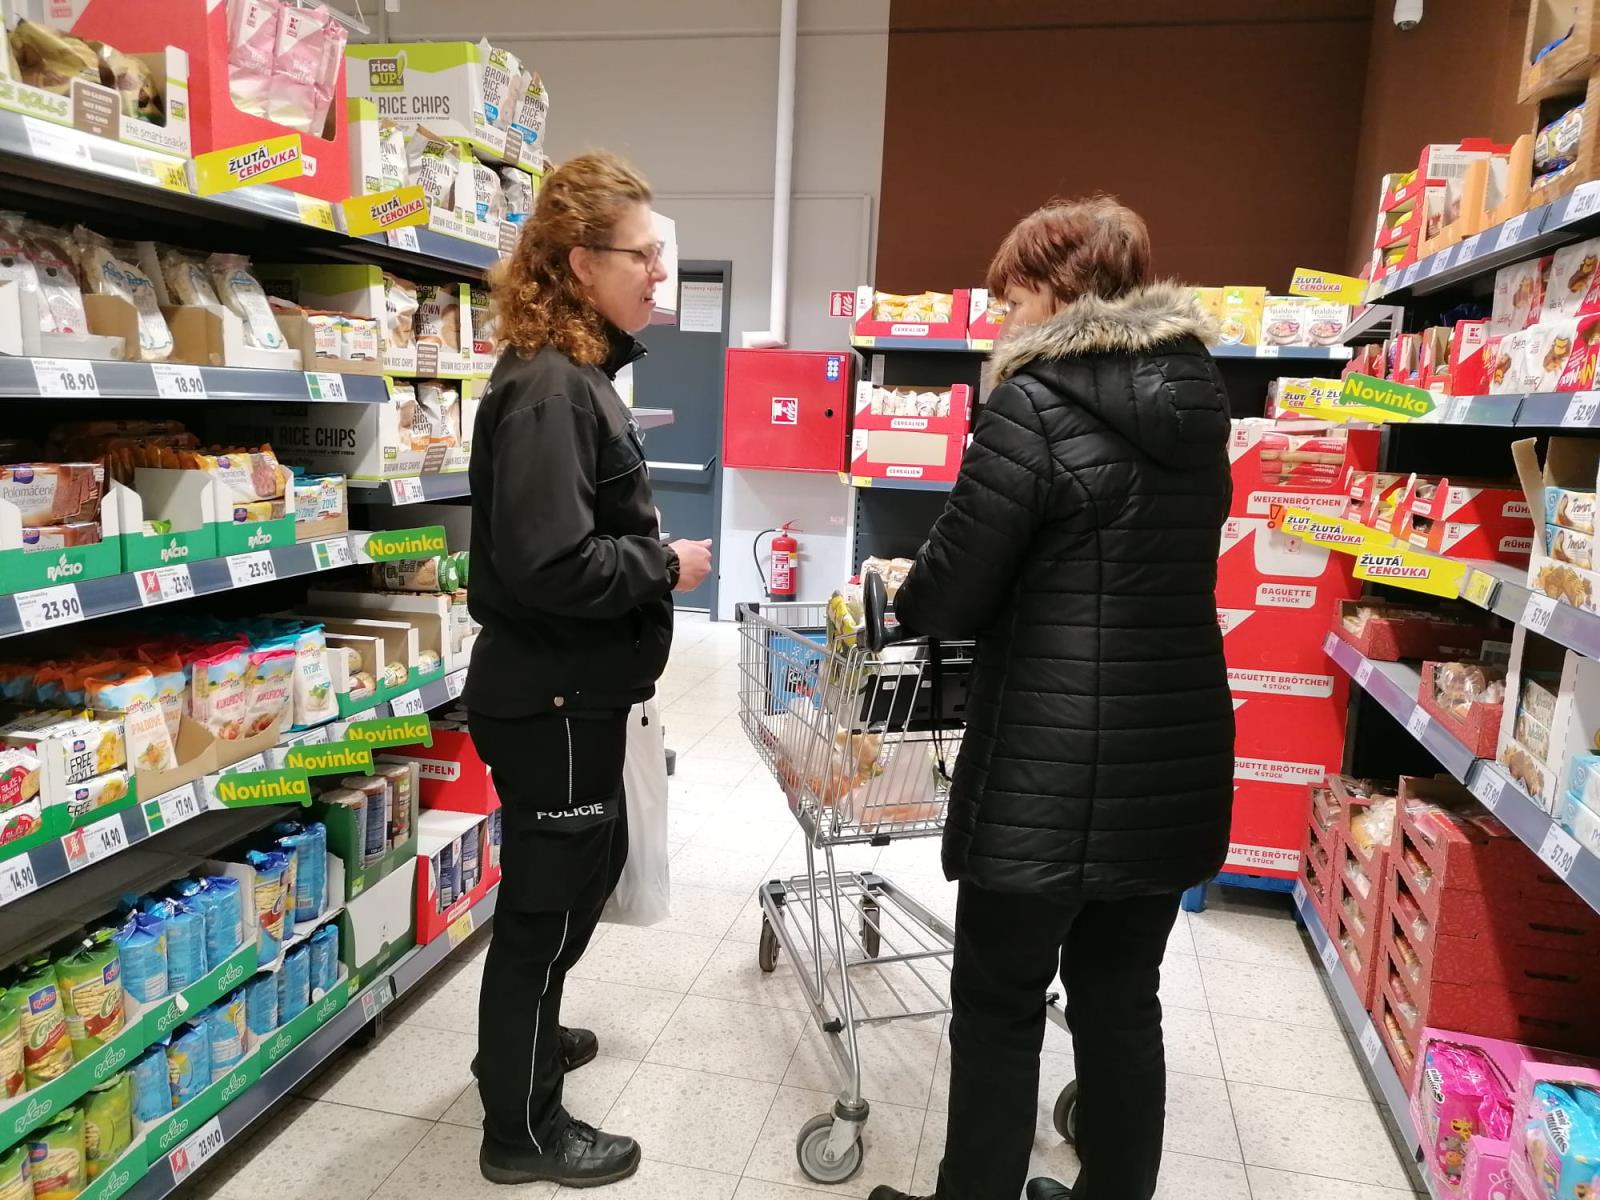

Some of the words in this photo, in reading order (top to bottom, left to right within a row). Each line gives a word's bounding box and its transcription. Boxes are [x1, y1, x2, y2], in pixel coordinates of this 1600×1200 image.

[371, 60, 396, 72] rice
[378, 96, 407, 114] RICE
[412, 95, 450, 114] CHIPS
[483, 89, 501, 105] HIPS
[521, 105, 540, 119] RICE
[518, 114, 542, 130] CHIPS
[229, 145, 266, 172] ŽLUTÁ
[239, 148, 297, 179] CENOVKA
[421, 158, 450, 177] BROWN
[420, 167, 438, 183] RICE
[371, 195, 400, 218] ŽLUTÁ
[380, 200, 423, 225] CENOVKA
[60, 372, 95, 391] 18.90
[175, 376, 203, 393] 18.90
[1284, 391, 1306, 401] ŽLUT
[1345, 378, 1429, 414] Novinka
[280, 426, 311, 446] RICE
[315, 427, 356, 448] CHIPS
[1253, 495, 1341, 507] WEIZENBRÖTCHEN
[1288, 516, 1310, 525] ŽLUT
[1310, 524, 1341, 533] ŽLUTÁ
[368, 534, 445, 558] Novinka
[1315, 533, 1361, 544] CENOVKA
[1360, 553, 1402, 566] ŽLUTÁ
[47, 558, 83, 582] RACIO
[248, 560, 274, 578] 23.90
[1367, 566, 1427, 577] CENOVKA
[172, 575, 192, 594] 23.90
[1261, 587, 1312, 598] BAGUETTE
[1277, 595, 1300, 604] STÜCK
[42, 597, 80, 621] 23.90
[1531, 608, 1551, 628] 57.90
[1227, 672, 1277, 683] BAGUETTE
[1278, 675, 1329, 687] BRÖTCHEN
[140, 701, 153, 713] VITA
[406, 697, 422, 714] 17.90
[348, 721, 429, 744] Novinka
[70, 751, 92, 774] FREE
[287, 748, 370, 771] Novinka
[1234, 761, 1268, 771] GUETTE
[1270, 764, 1320, 776] BRÖTCHEN
[420, 763, 455, 776] FFELN
[218, 776, 307, 802] Novinka
[175, 798, 193, 817] 17.90
[536, 802, 604, 820] POLICIE
[100, 826, 122, 851] 14.90
[1227, 847, 1260, 860] UETTE
[1262, 849, 1299, 862] BRÖTCH
[1252, 856, 1274, 865] STÜCK
[1550, 843, 1573, 873] 57.90
[10, 866, 35, 892] 14.90
[198, 1132, 216, 1158] 23.90
